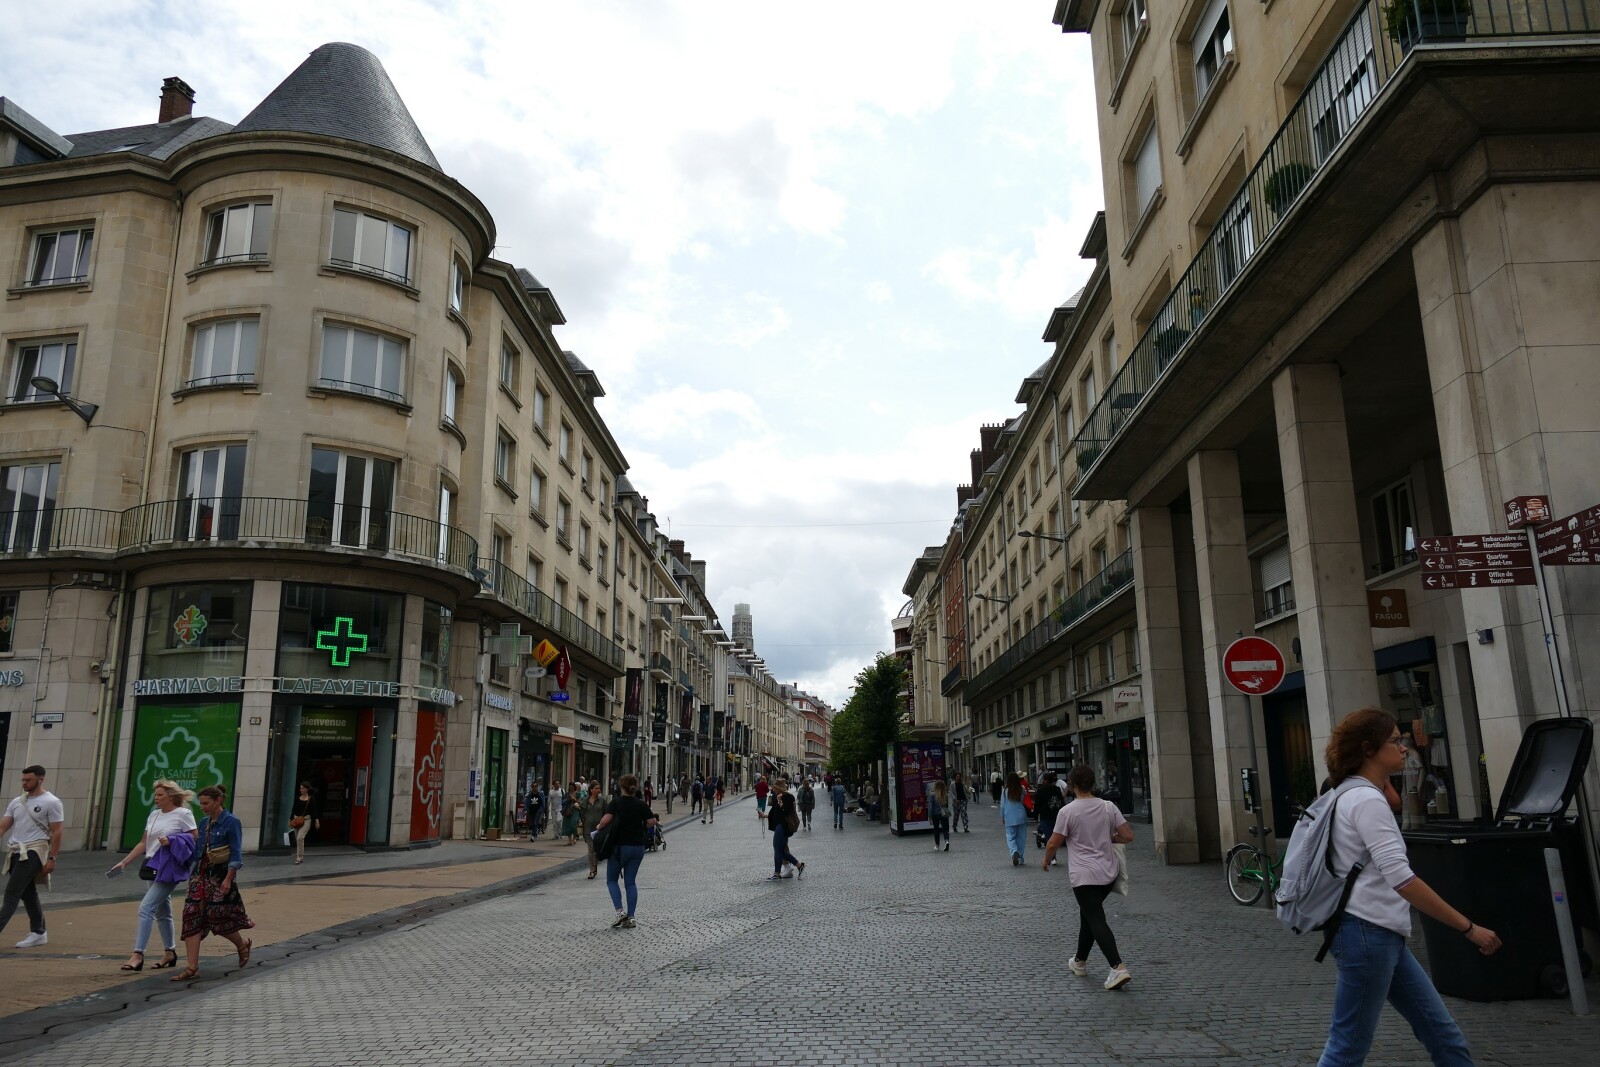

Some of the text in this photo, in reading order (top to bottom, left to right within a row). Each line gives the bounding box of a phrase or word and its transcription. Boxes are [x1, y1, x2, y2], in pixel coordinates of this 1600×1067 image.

[541, 650, 556, 665] PRESSE
[133, 676, 242, 696] PHARMACIE
[278, 677, 399, 698] LAFAYETTE
[1118, 690, 1138, 699] free
[300, 716, 347, 727] Bienvenue
[153, 766, 198, 779] LA SANTÉ
